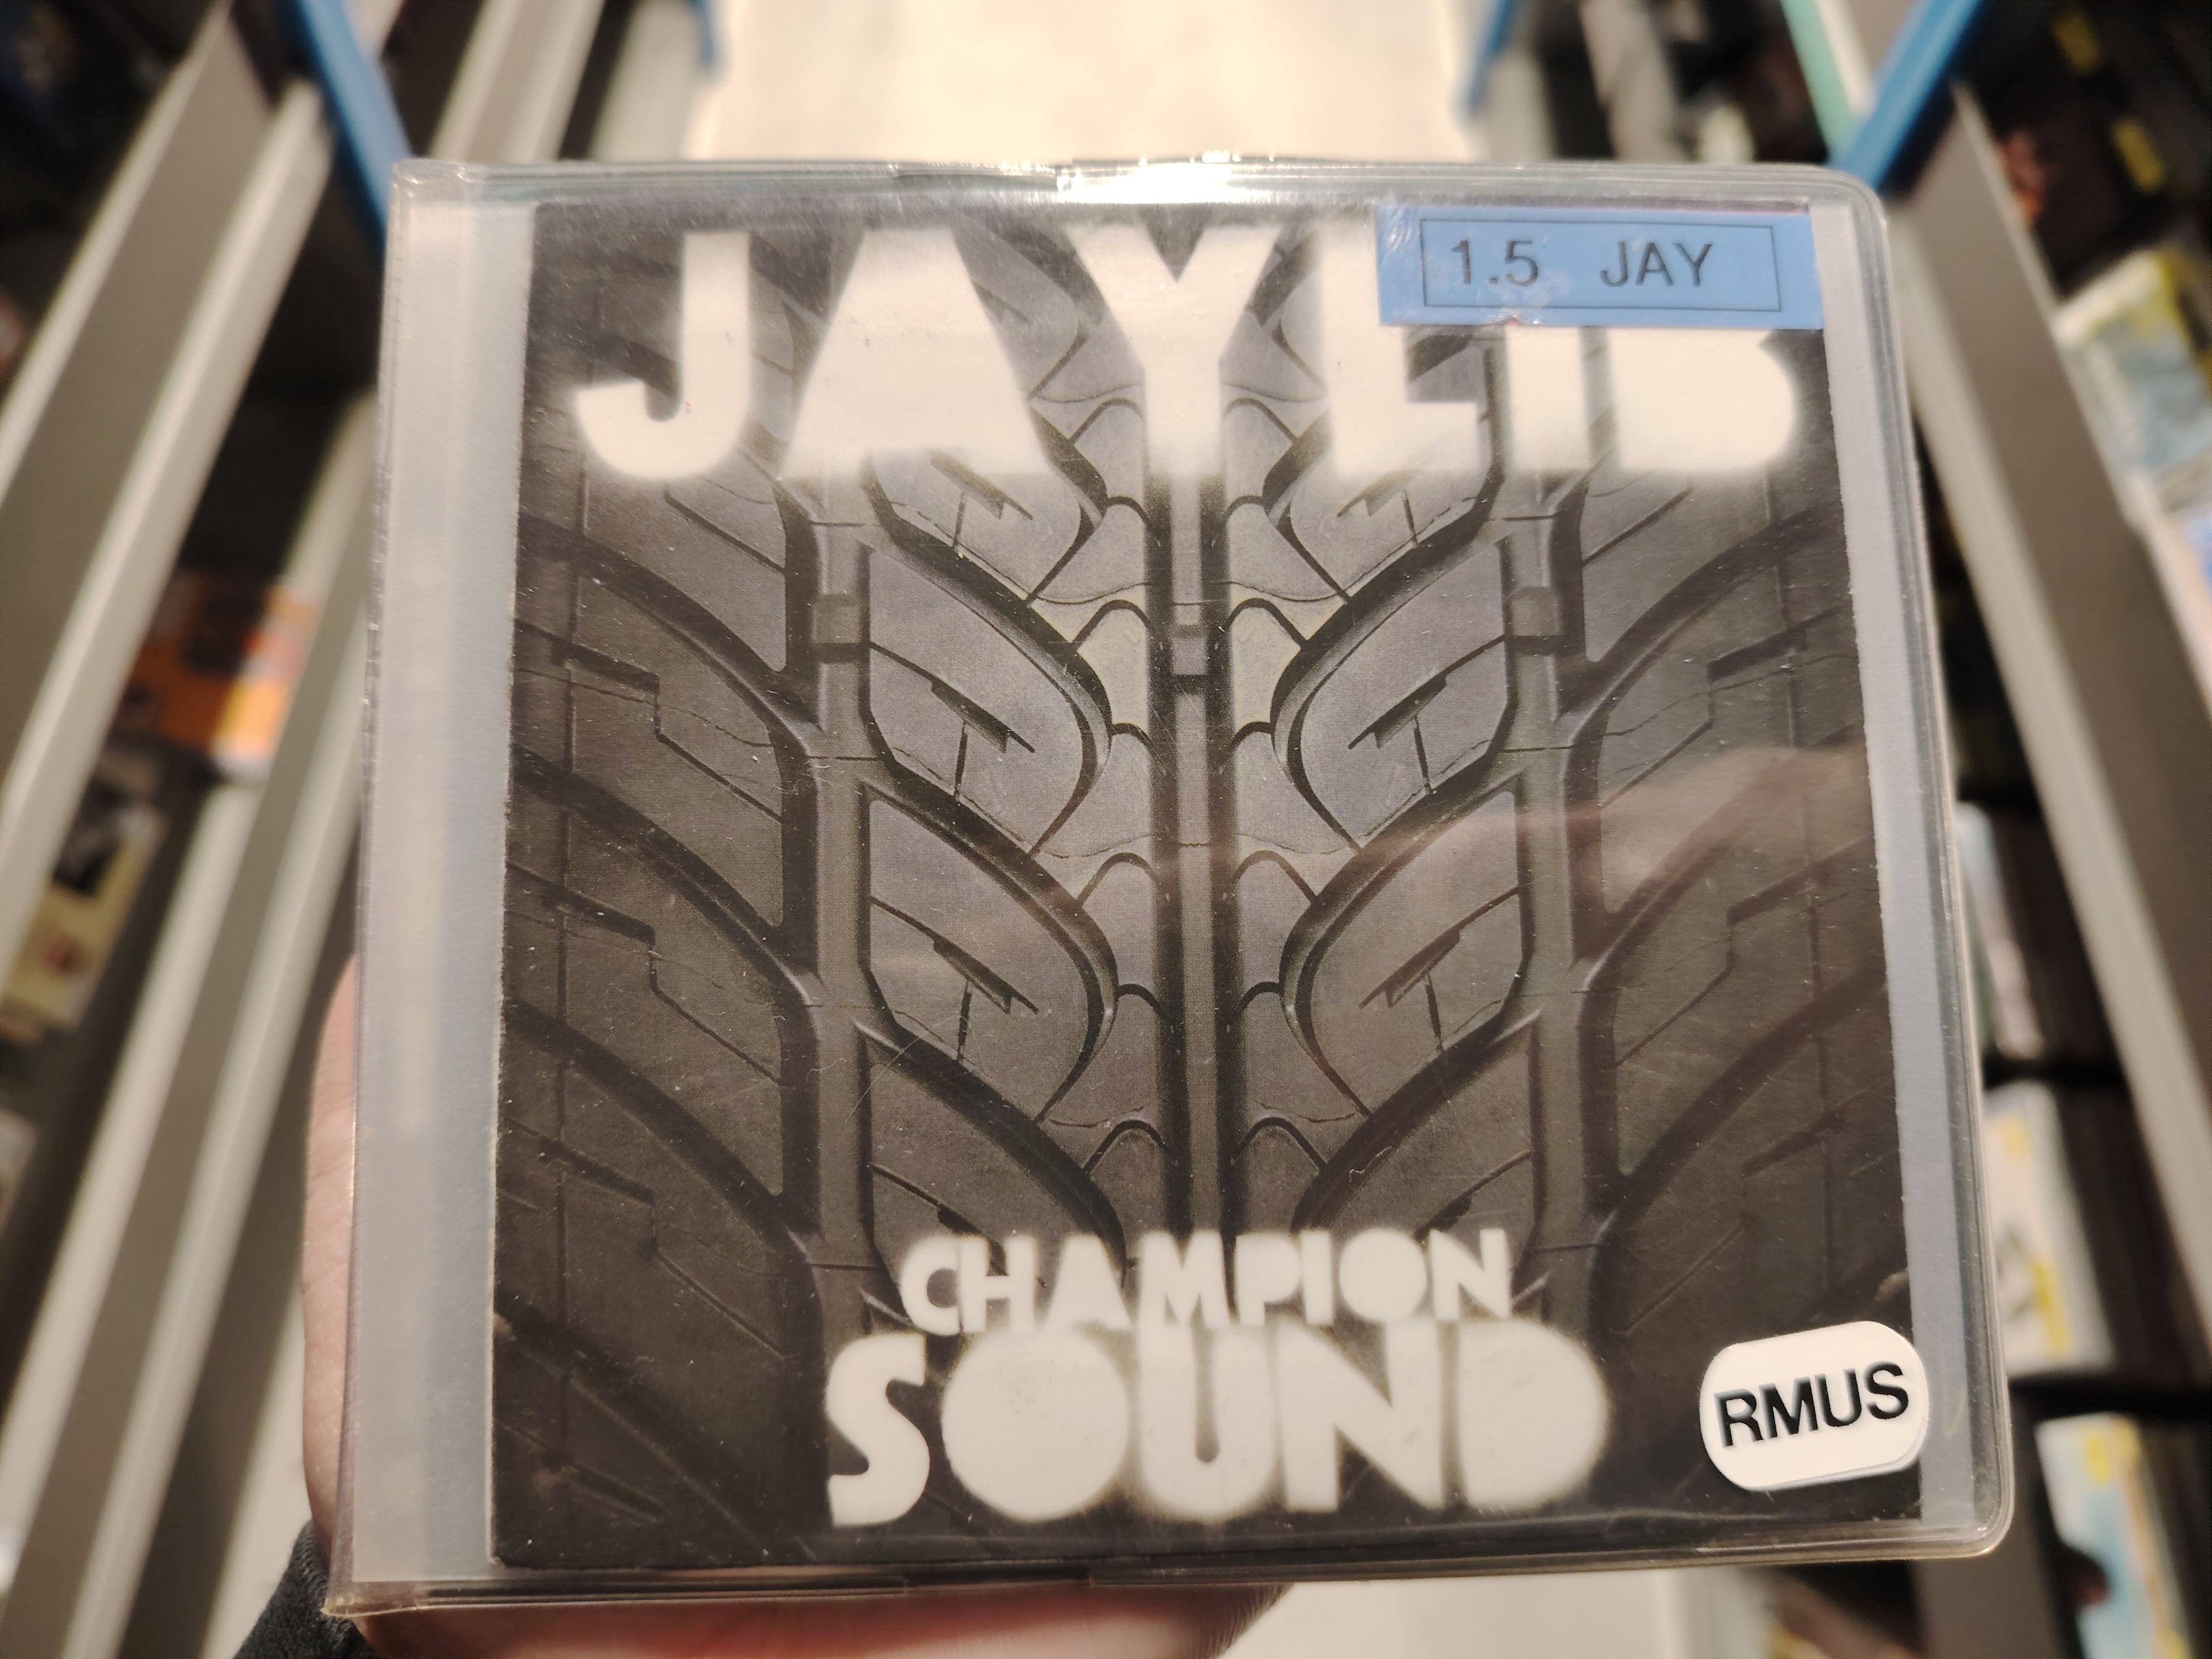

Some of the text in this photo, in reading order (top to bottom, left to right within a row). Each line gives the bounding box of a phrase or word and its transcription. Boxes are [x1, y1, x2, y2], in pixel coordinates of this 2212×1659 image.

[1450, 238, 1715, 289] 1.5 JAY
[574, 221, 1800, 482] JAYLIB
[898, 1228, 1513, 1336] CHAMPION
[824, 1317, 1612, 1527] SOUND
[1714, 1361, 1911, 1447] RMUS
